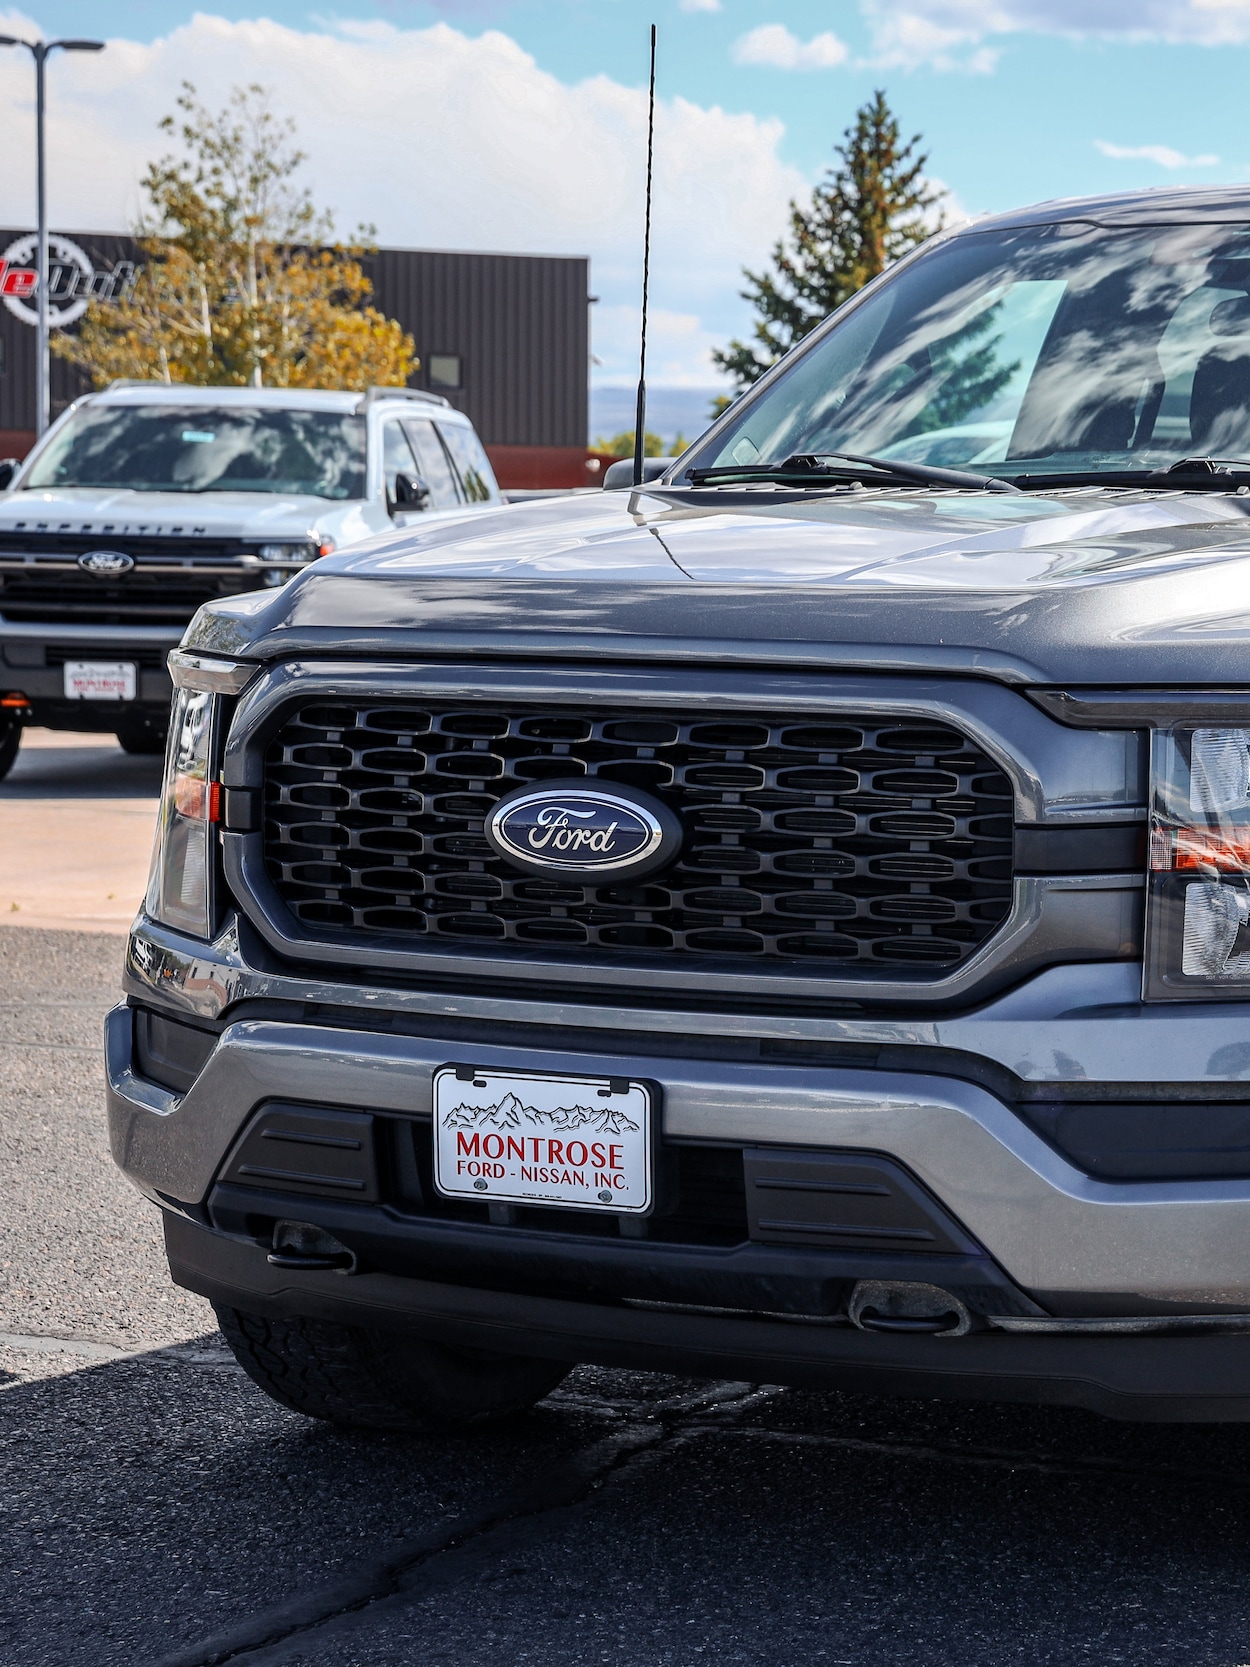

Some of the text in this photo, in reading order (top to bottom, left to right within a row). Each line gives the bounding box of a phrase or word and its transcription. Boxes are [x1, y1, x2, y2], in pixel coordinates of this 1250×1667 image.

[528, 806, 619, 852] Ford
[457, 1131, 624, 1170] MONTROSE
[457, 1160, 505, 1179] FORD
[521, 1166, 589, 1190] NISSAN,
[594, 1172, 629, 1190] INC.
